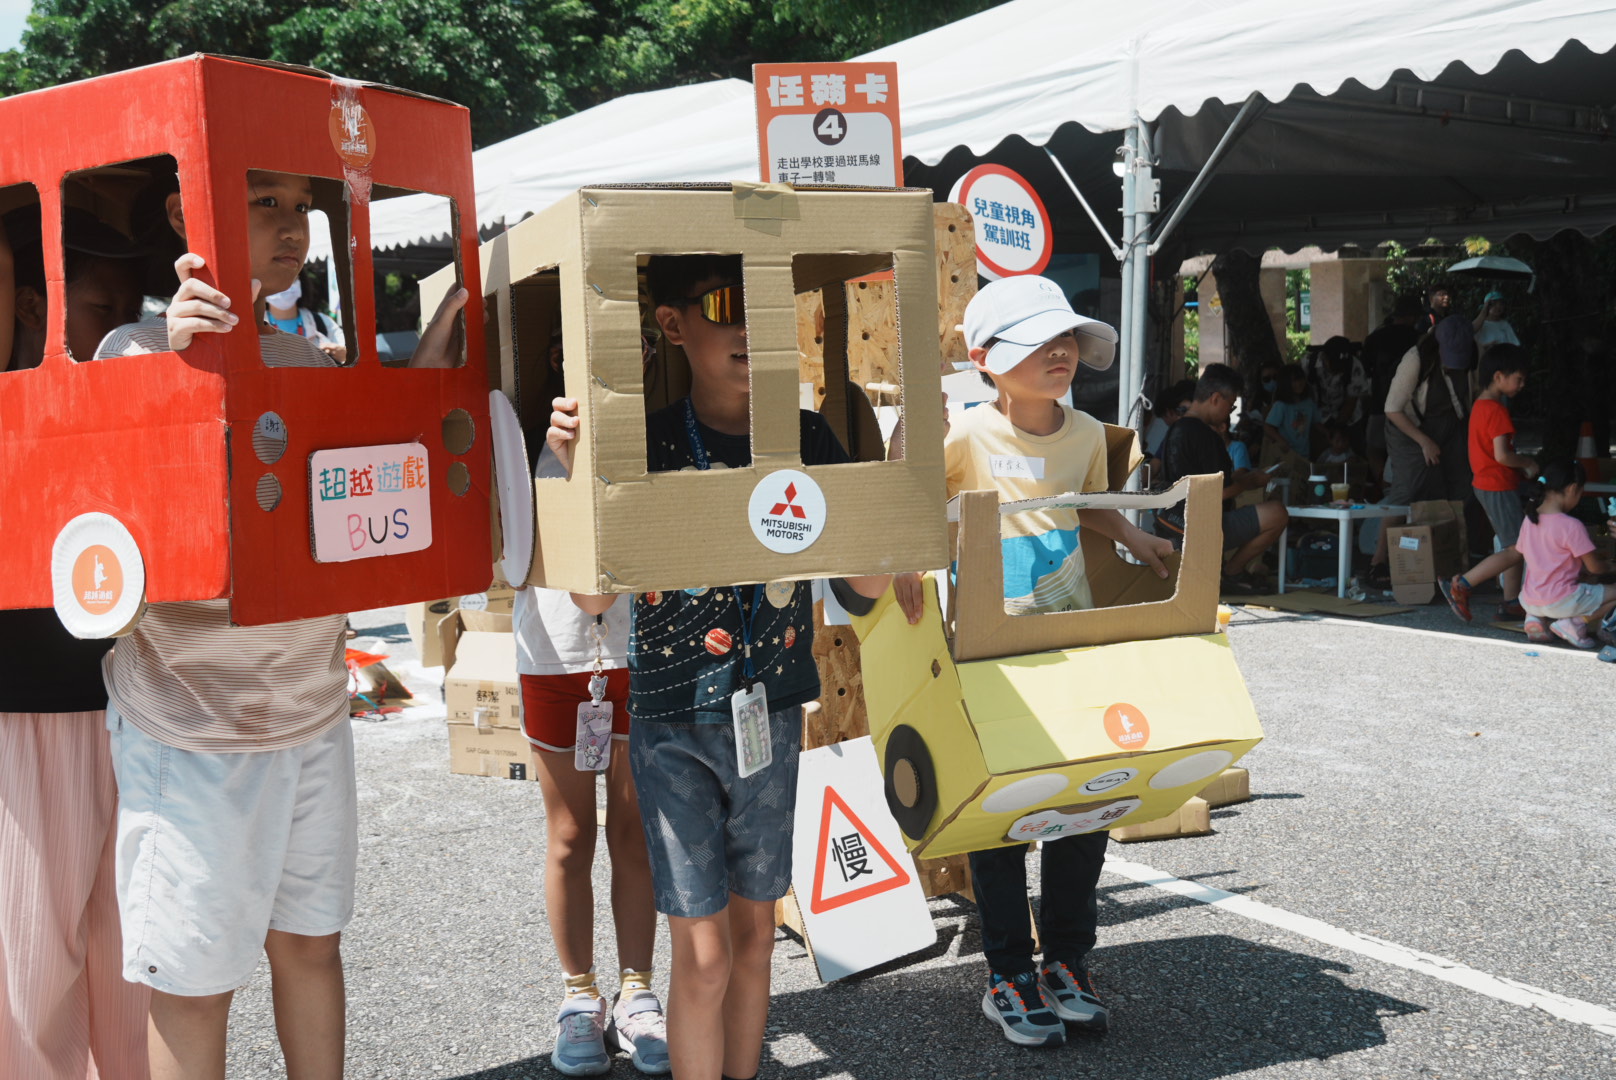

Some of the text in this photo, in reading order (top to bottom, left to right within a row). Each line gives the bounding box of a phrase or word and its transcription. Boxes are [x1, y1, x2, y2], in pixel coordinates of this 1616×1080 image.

[766, 73, 888, 107] 任務卡
[817, 114, 843, 139] 4
[777, 154, 881, 170] 走出學校要過斑馬線
[778, 170, 836, 184] 車子一轉彎
[973, 197, 1036, 229] 兒童視角
[983, 222, 1032, 251] 駕訓班
[319, 456, 427, 502] 超越遊戲
[347, 508, 410, 551] BUS
[761, 518, 812, 532] MITSUBISHI
[766, 528, 804, 541] MOTORS
[832, 832, 873, 882] 慢
